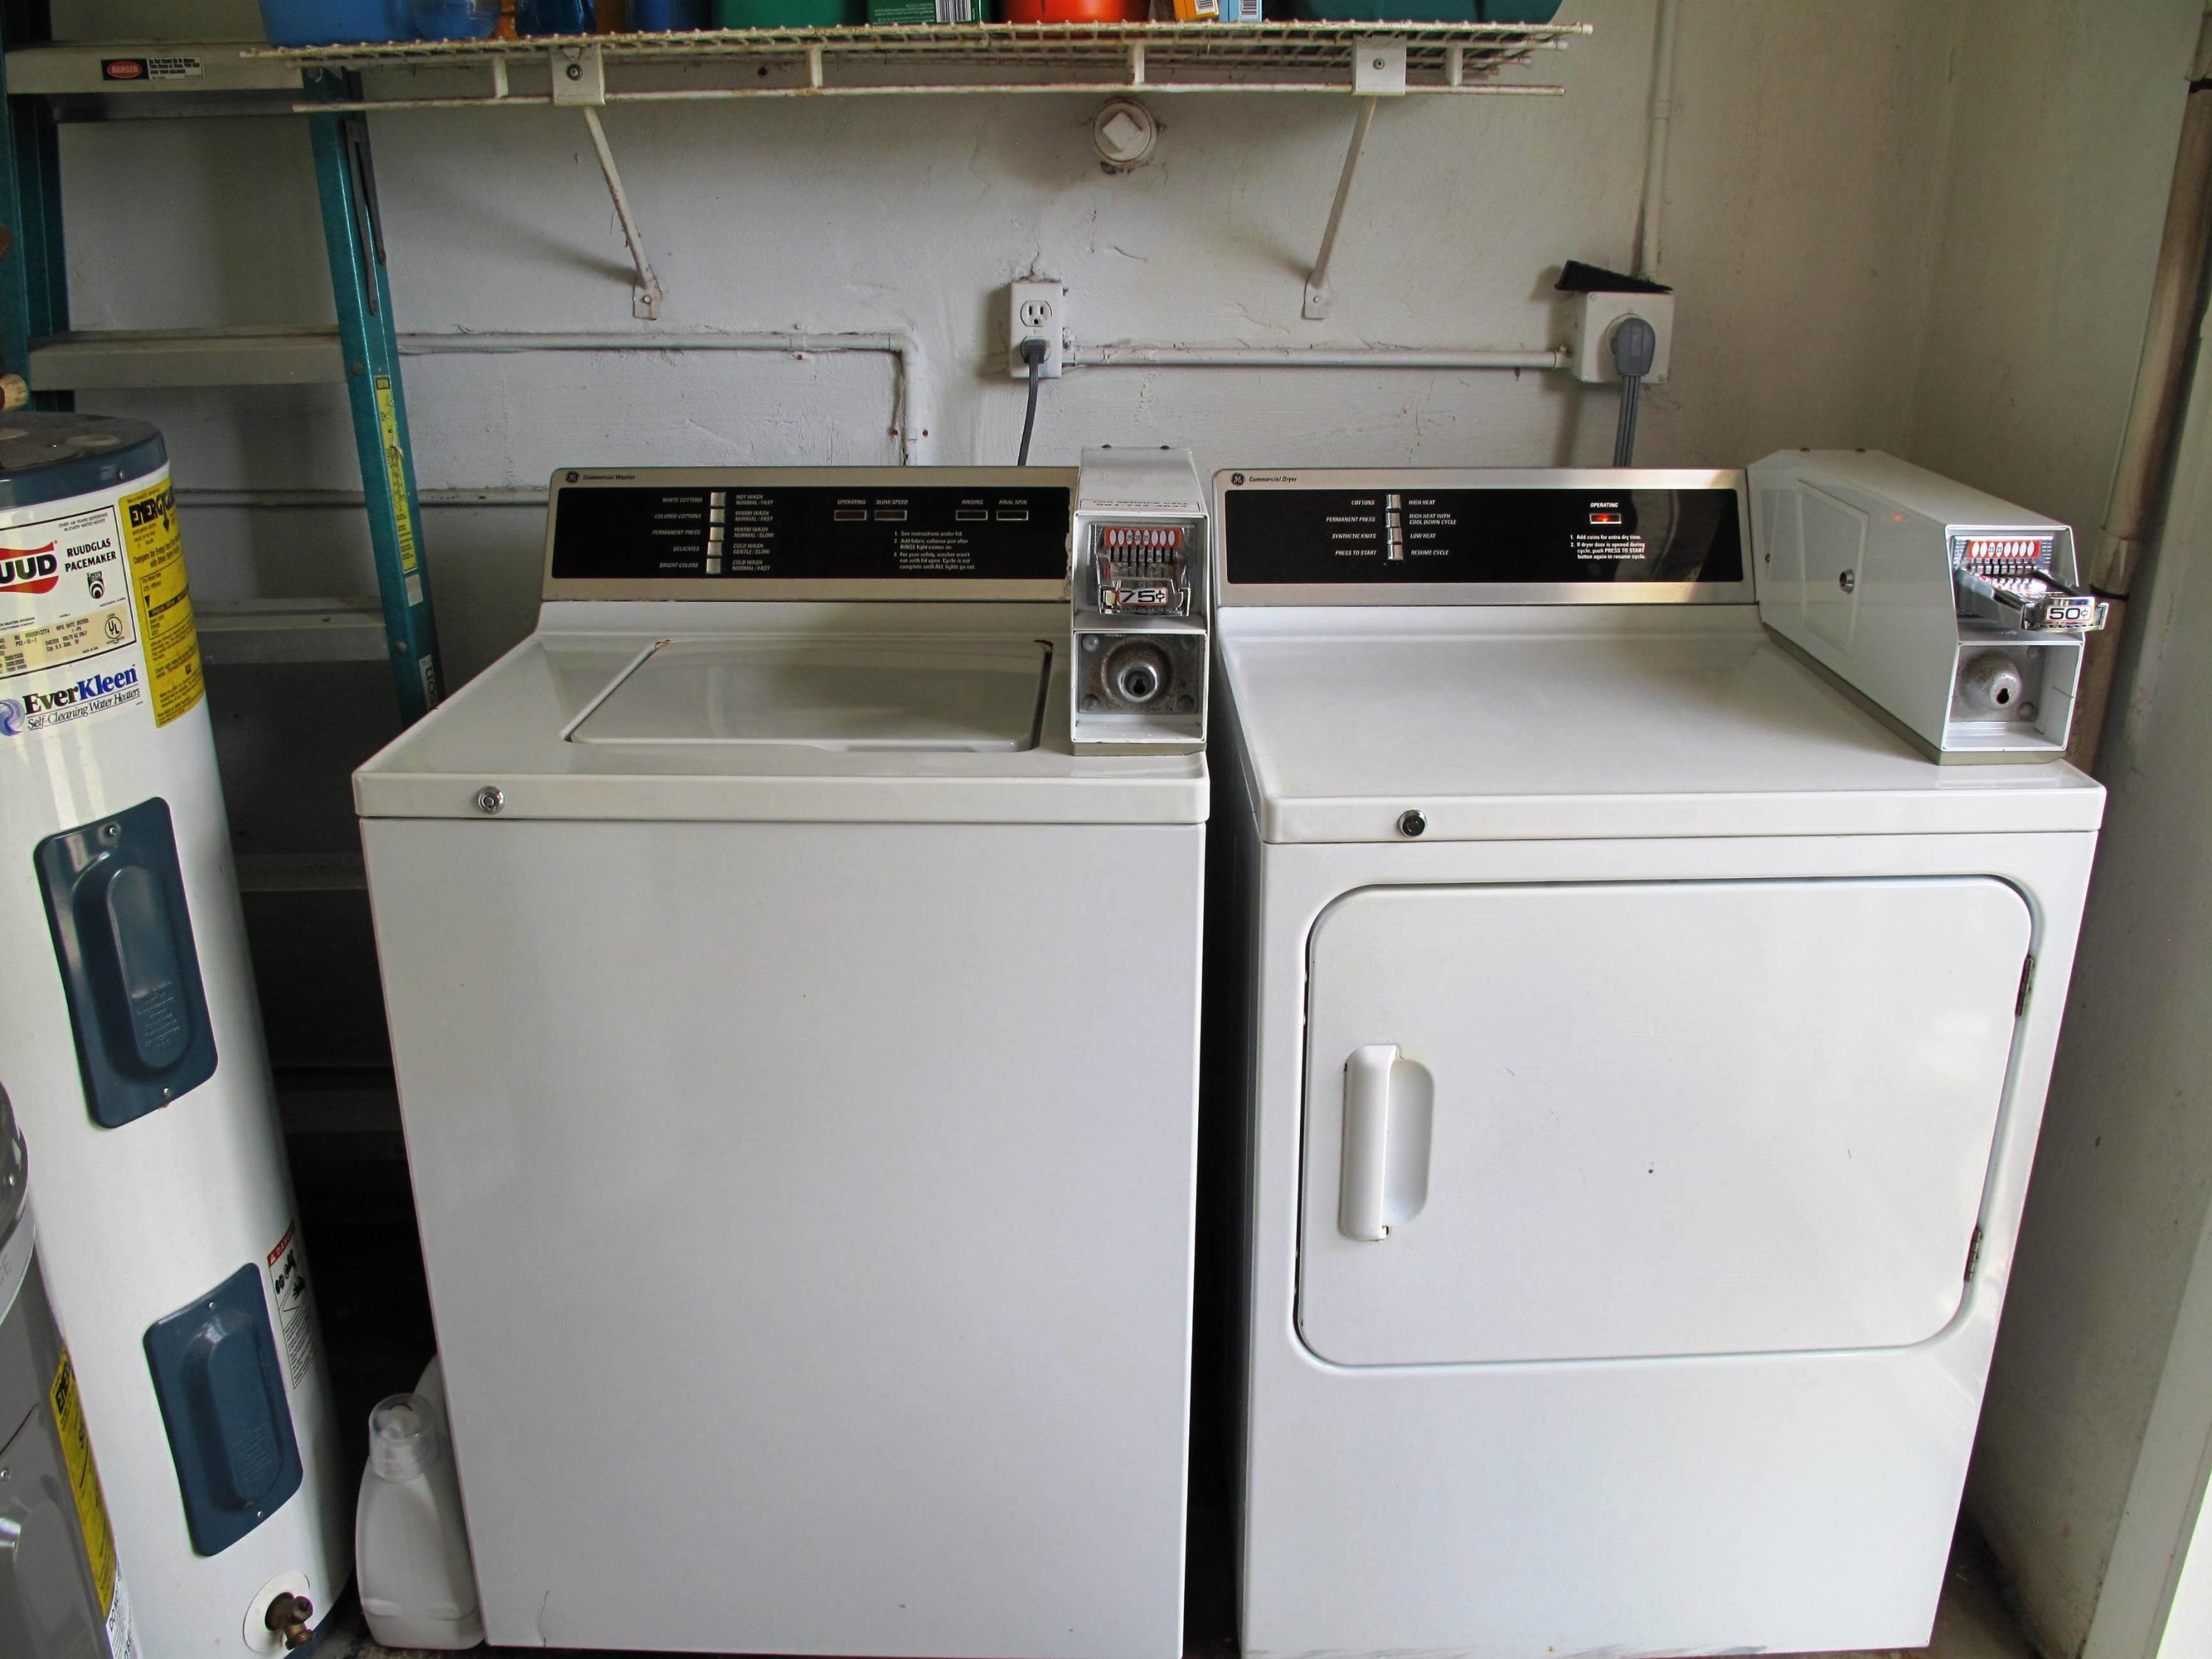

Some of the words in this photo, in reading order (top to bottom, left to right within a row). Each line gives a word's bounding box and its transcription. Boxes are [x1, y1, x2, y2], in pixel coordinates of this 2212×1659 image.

[111, 65, 139, 74] DANGER
[66, 538, 111, 557] RUUDGLAS
[65, 551, 116, 572] PACEMAKER
[1119, 590, 1165, 602] 75¢
[2049, 608, 2089, 619] 50¢
[108, 621, 119, 635] UL
[22, 667, 139, 715] EverKleen
[27, 706, 88, 729] Self-Cleaning
[88, 697, 113, 712] Water
[114, 688, 140, 704] Heaters
